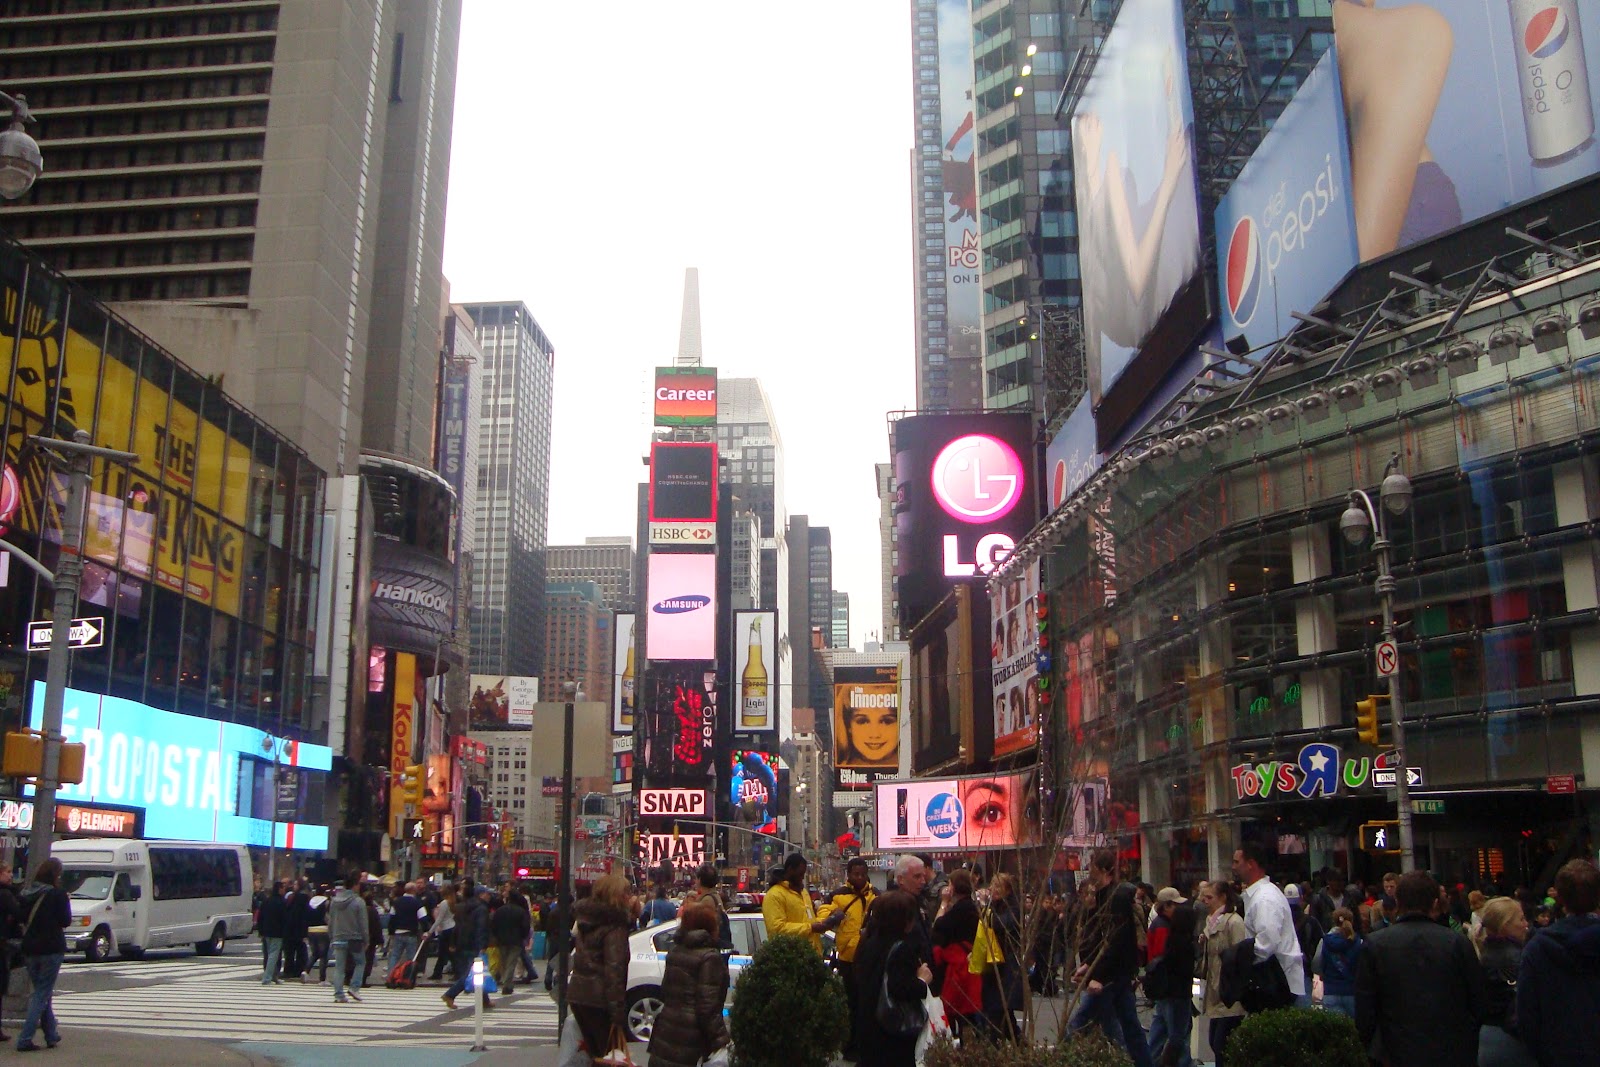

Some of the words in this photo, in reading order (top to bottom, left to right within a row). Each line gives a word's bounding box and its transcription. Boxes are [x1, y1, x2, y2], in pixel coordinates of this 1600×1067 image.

[1528, 63, 1551, 113] pepsi
[1266, 152, 1336, 286] pepsi
[953, 275, 970, 283] ON
[656, 387, 715, 401] Career
[446, 382, 463, 474] TIMES
[154, 423, 195, 476] THE
[171, 487, 235, 573] KING
[652, 528, 691, 540] HSBC
[943, 534, 1016, 577] LG
[660, 599, 704, 609] SAMSUNG
[70, 628, 92, 639] WAY
[993, 650, 1038, 688] WORKAHOLICS
[703, 705, 714, 748] zero
[393, 702, 412, 788] Kodak
[1231, 762, 1297, 800] TOYS
[1380, 774, 1395, 782] ONE
[644, 792, 703, 813] SNAP
[940, 796, 960, 821] 4
[81, 811, 126, 832] ELEMENT
[929, 822, 960, 835] WEEKS
[864, 858, 888, 867] watch
